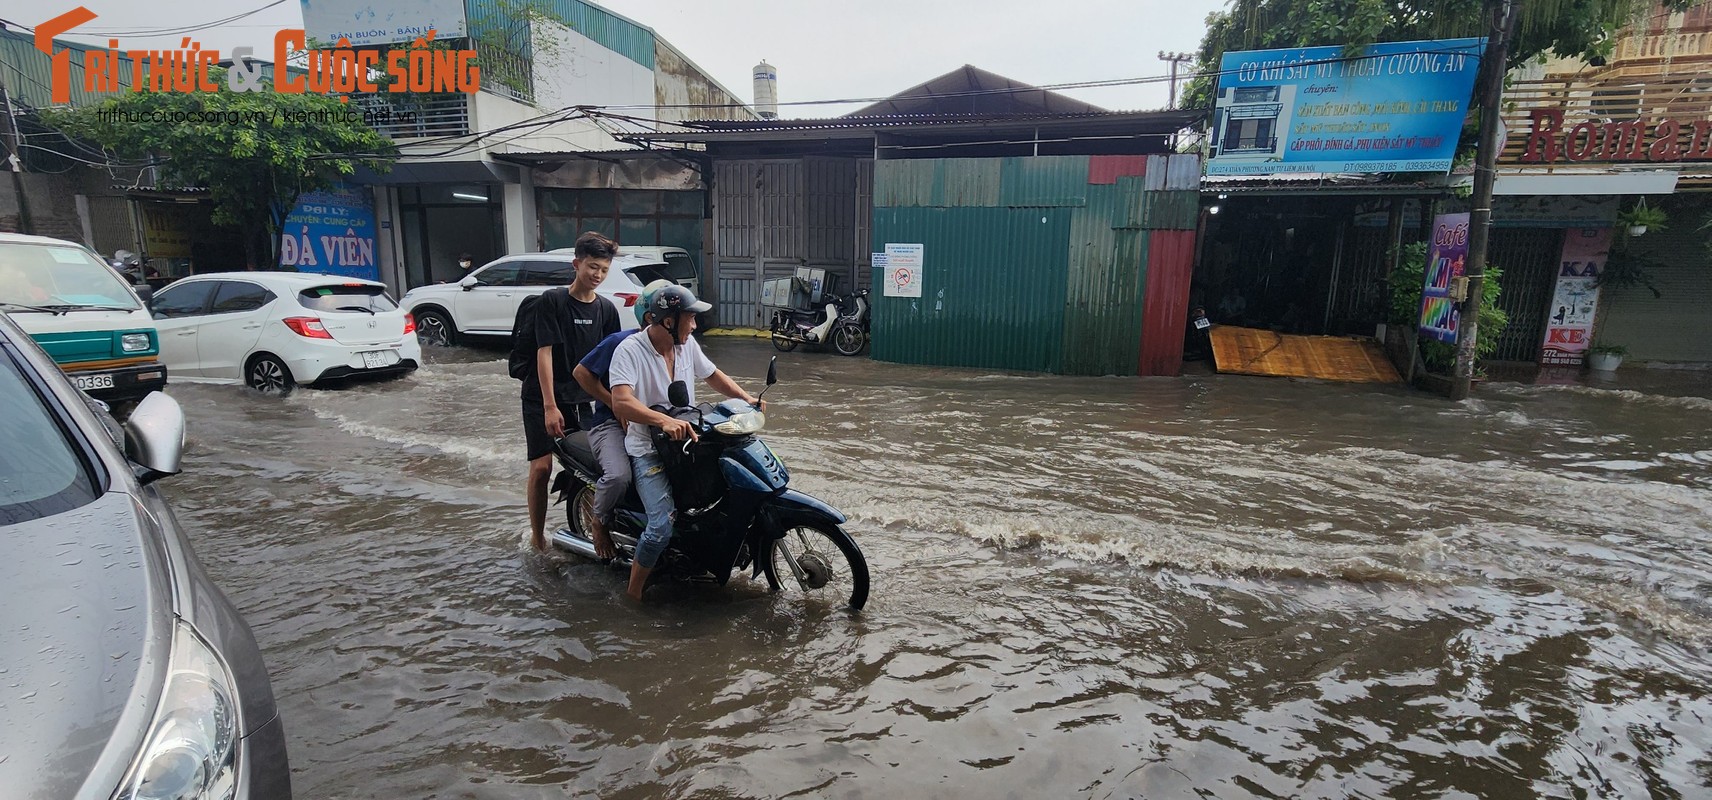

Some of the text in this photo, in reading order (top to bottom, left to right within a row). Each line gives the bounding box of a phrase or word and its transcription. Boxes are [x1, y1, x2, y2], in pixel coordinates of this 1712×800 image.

[1260, 54, 1288, 81] KHÍ
[1388, 47, 1441, 75] CƯỜNG
[1303, 83, 1339, 96] chuyên:
[1404, 160, 1450, 171] 0393634959
[323, 217, 349, 226] CUNG
[1435, 222, 1469, 249] Café
[281, 225, 374, 266] ĐÁ VIÊN
[1543, 349, 1557, 357] 272
